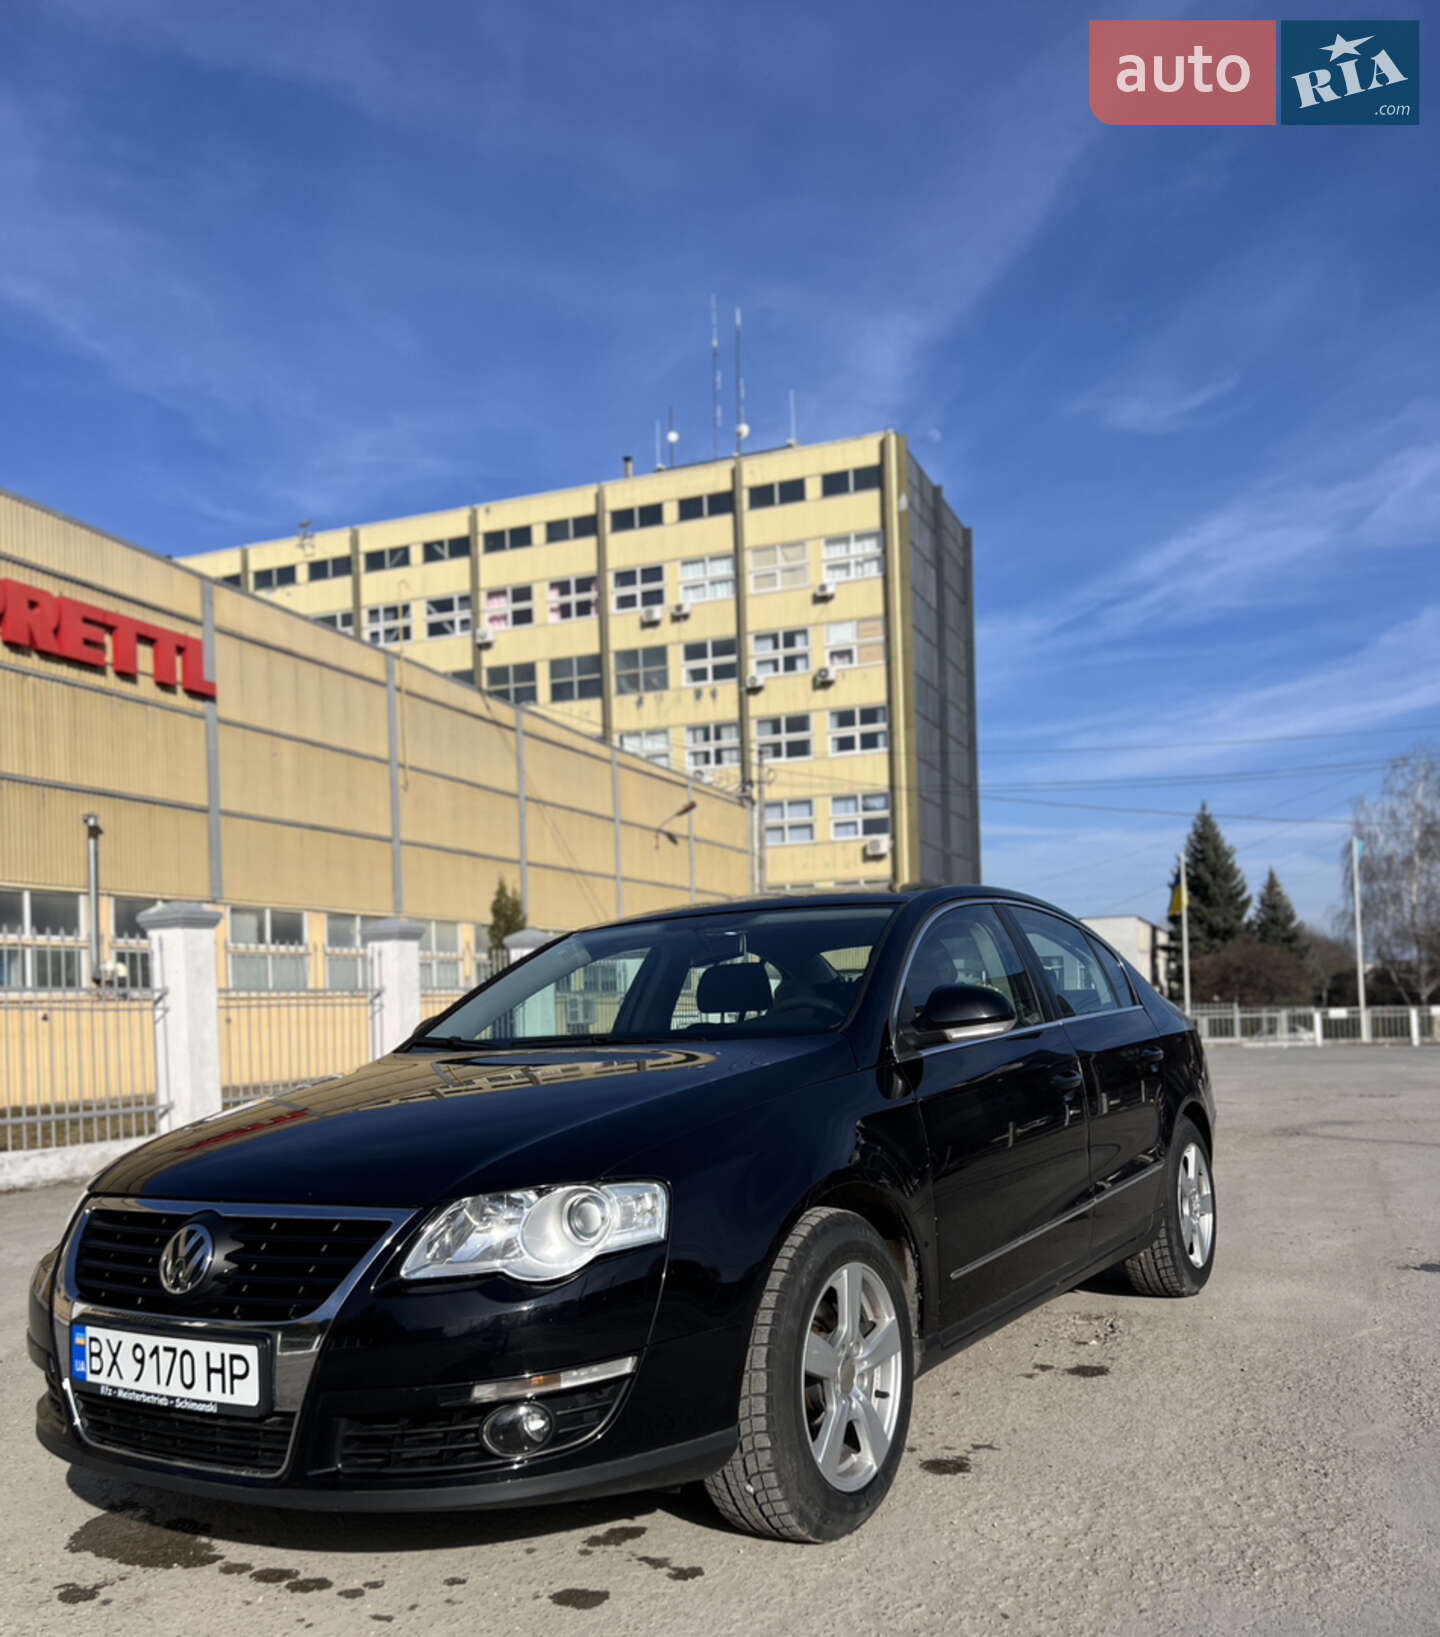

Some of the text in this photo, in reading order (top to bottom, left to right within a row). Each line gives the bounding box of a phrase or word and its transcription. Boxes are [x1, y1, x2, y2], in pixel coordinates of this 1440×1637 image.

[0, 578, 217, 698] RETTL
[89, 1336, 250, 1396] BX 9170 HP
